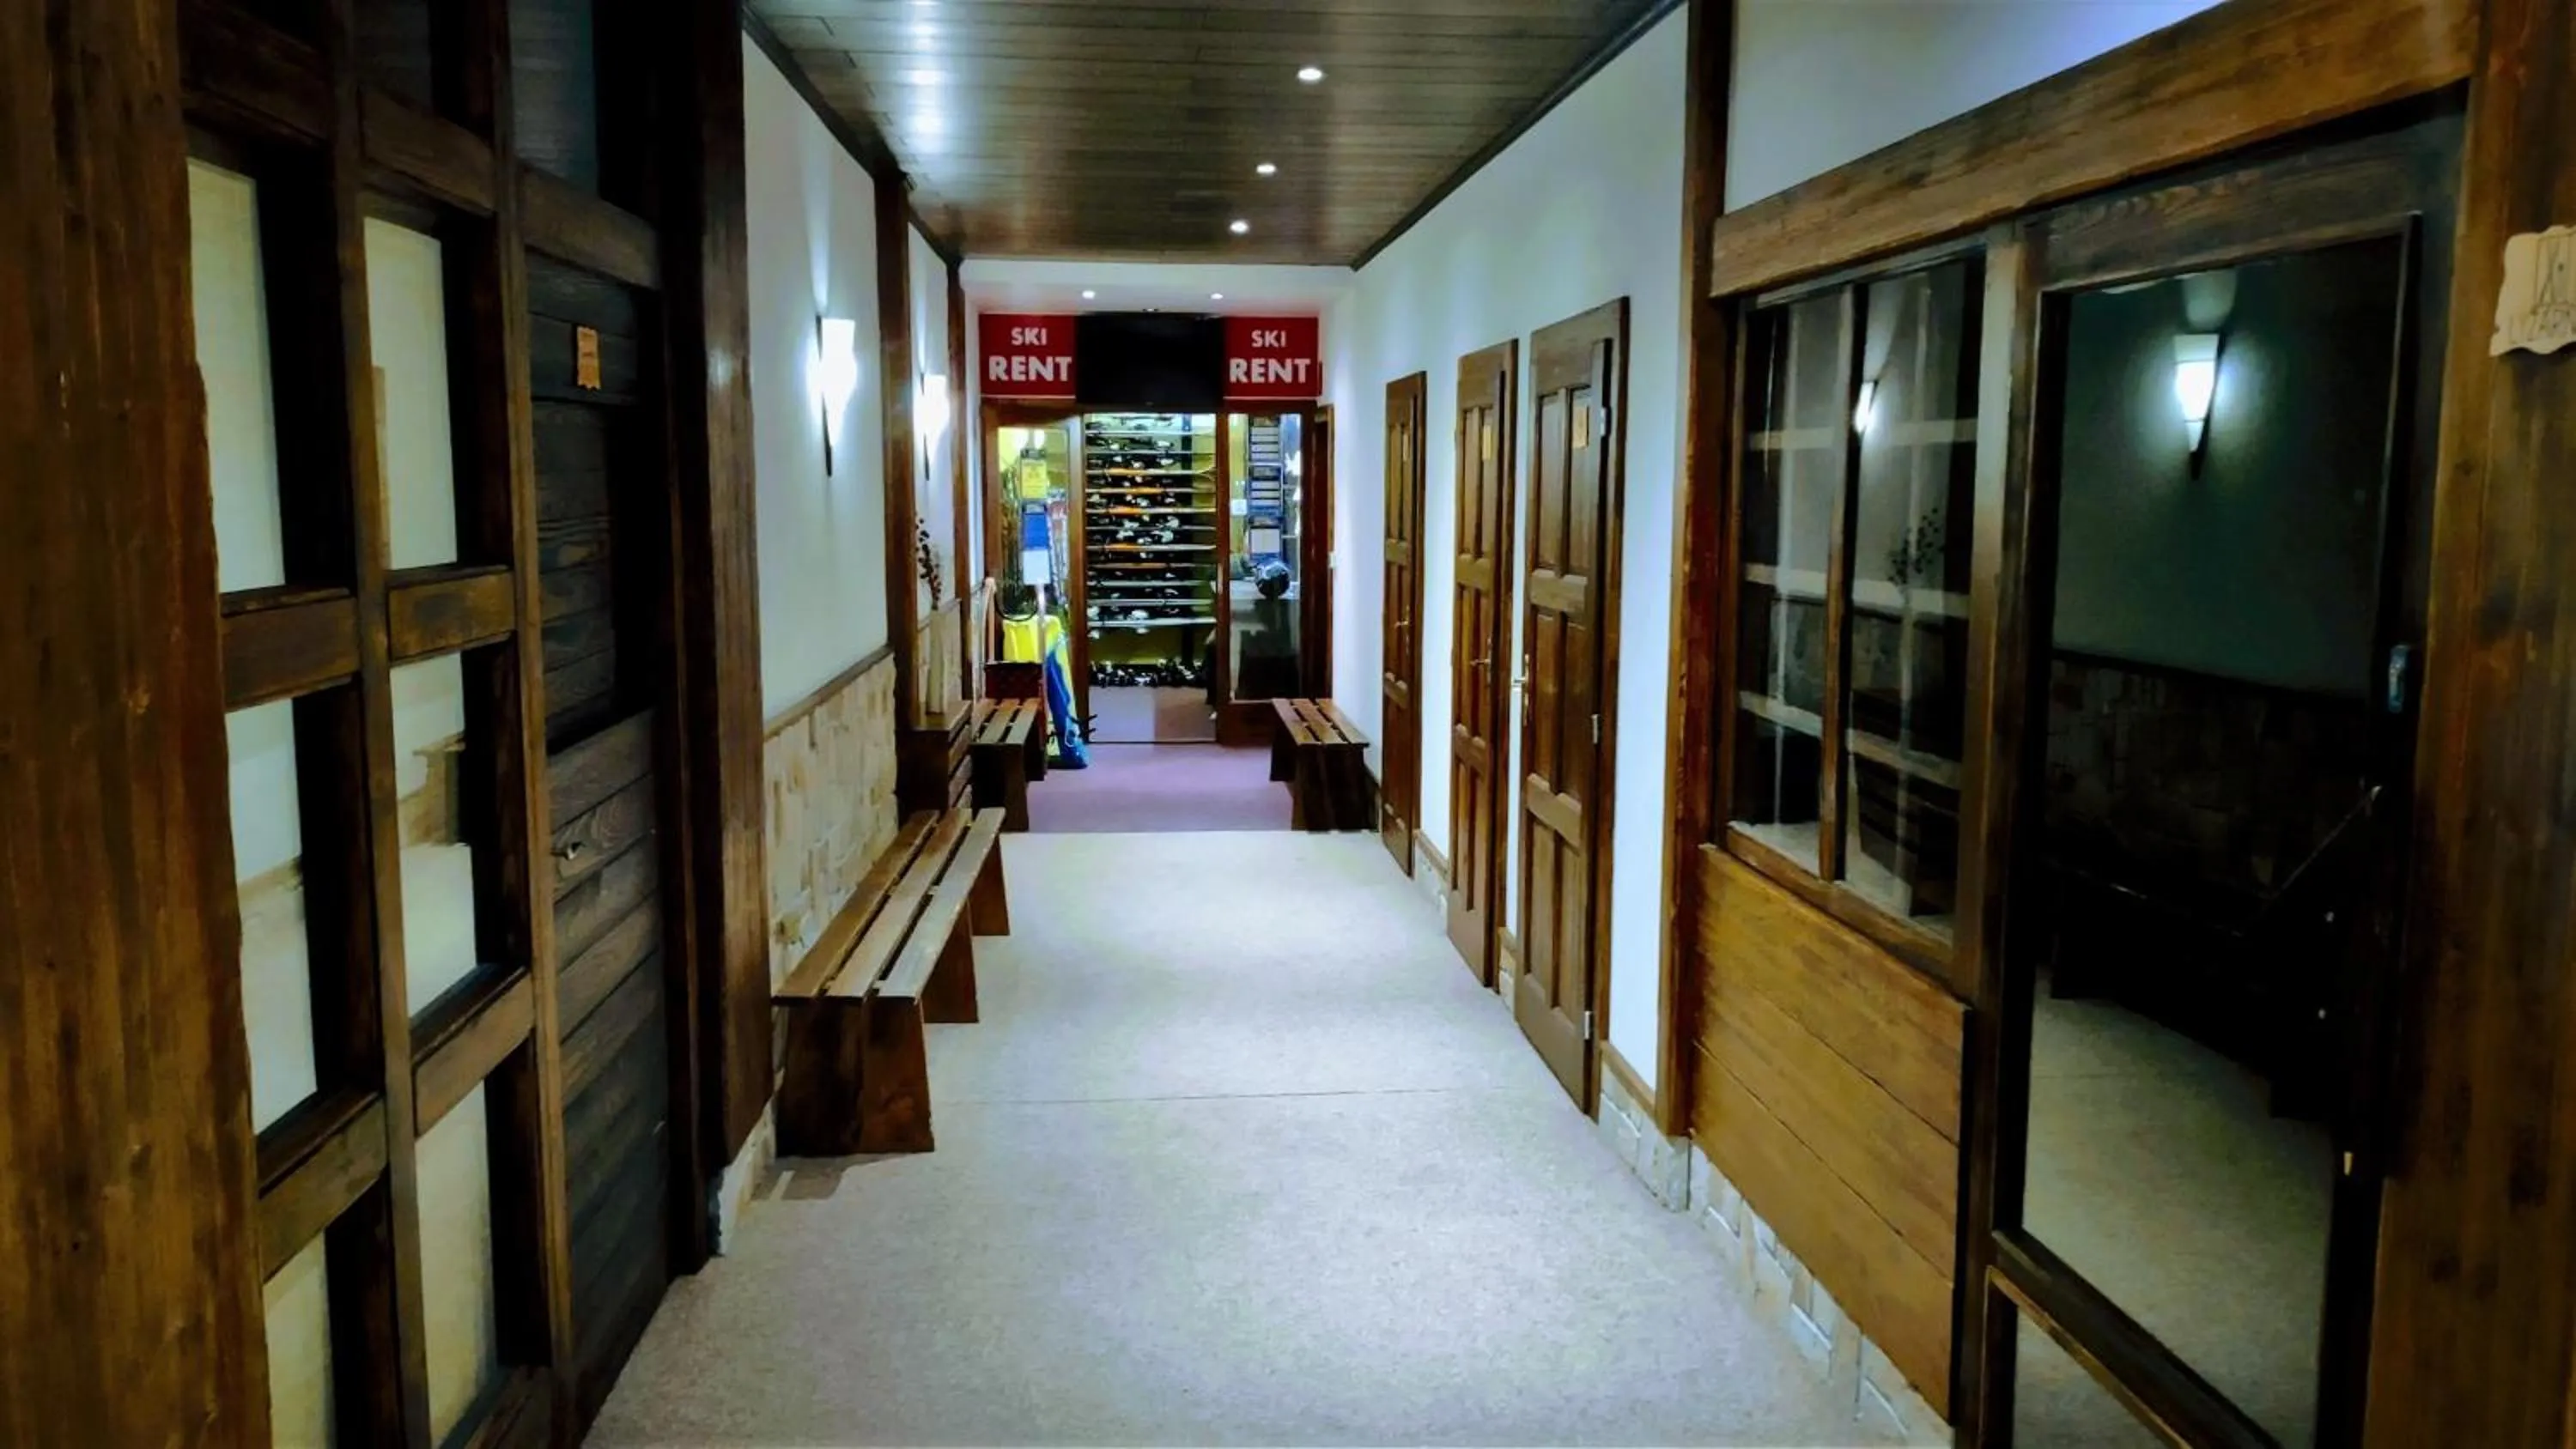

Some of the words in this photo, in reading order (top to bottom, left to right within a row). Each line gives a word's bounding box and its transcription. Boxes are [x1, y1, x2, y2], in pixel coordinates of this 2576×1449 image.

[1011, 327, 1048, 346] SKI
[1251, 330, 1286, 348] SKI
[988, 355, 1072, 382] RENT
[1229, 358, 1310, 383] RENT
